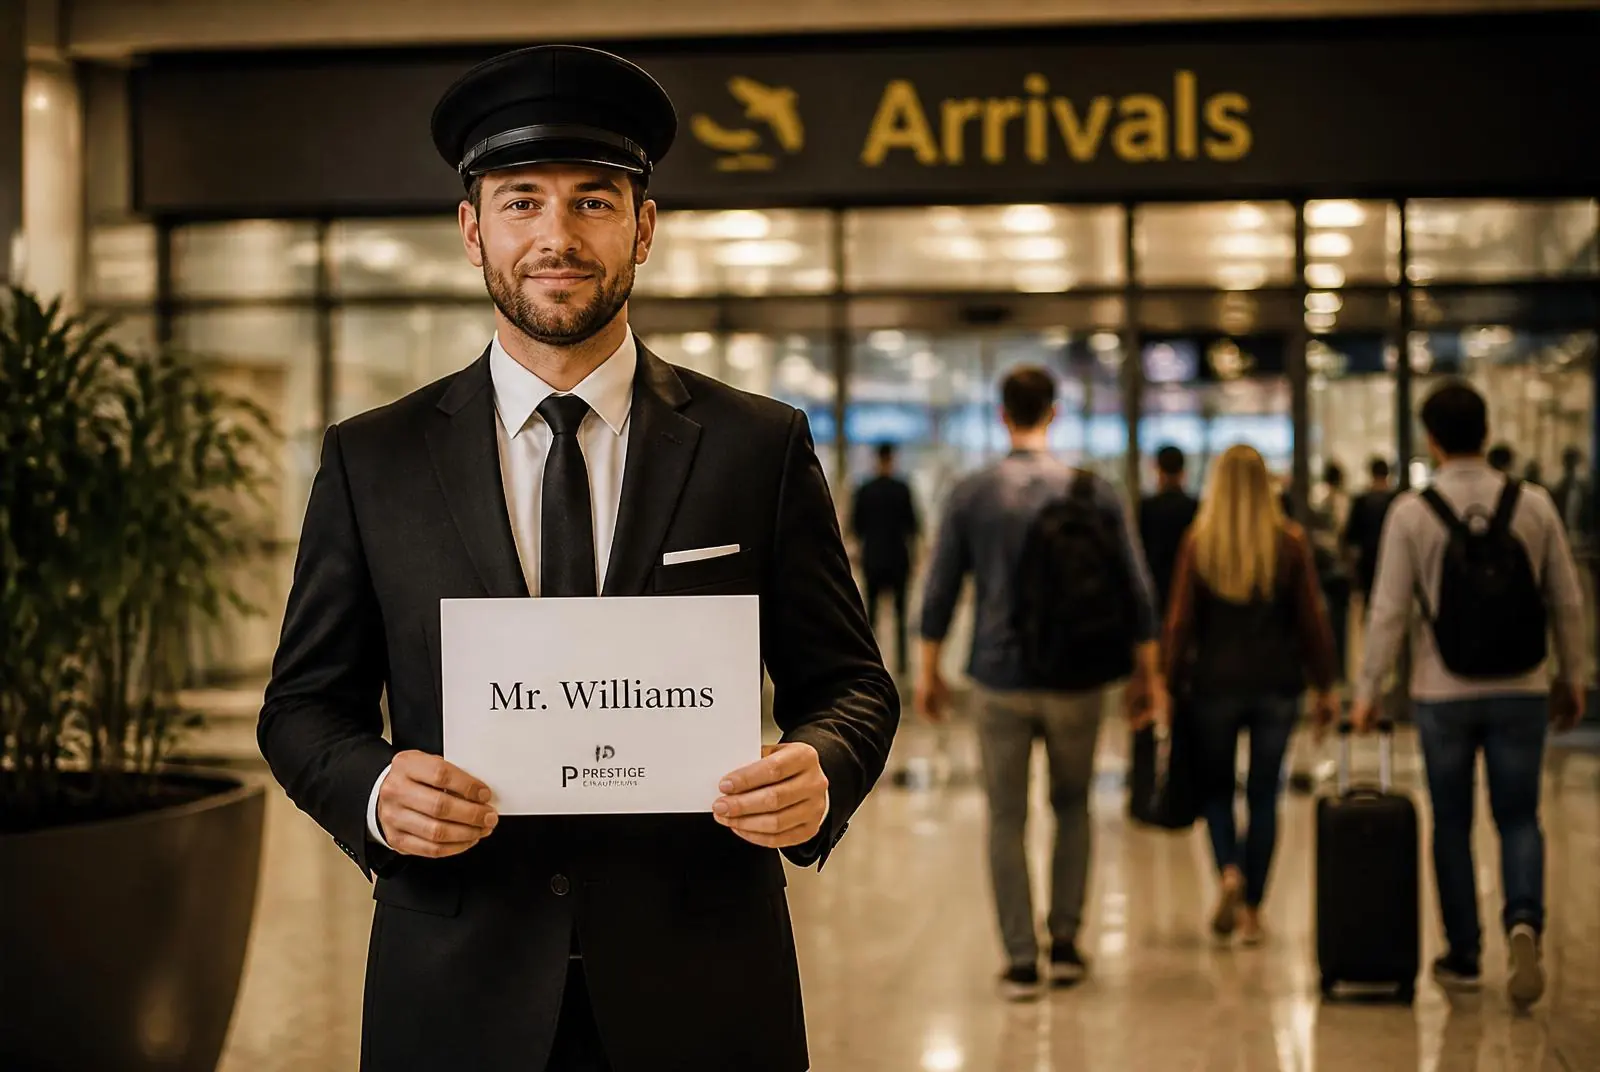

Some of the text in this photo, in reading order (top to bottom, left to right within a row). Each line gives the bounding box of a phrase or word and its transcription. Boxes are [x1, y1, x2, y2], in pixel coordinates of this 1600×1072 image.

[862, 70, 1252, 165] Arrivals
[490, 679, 714, 710] Mr. Williams
[583, 767, 646, 778] PRESTIGE
